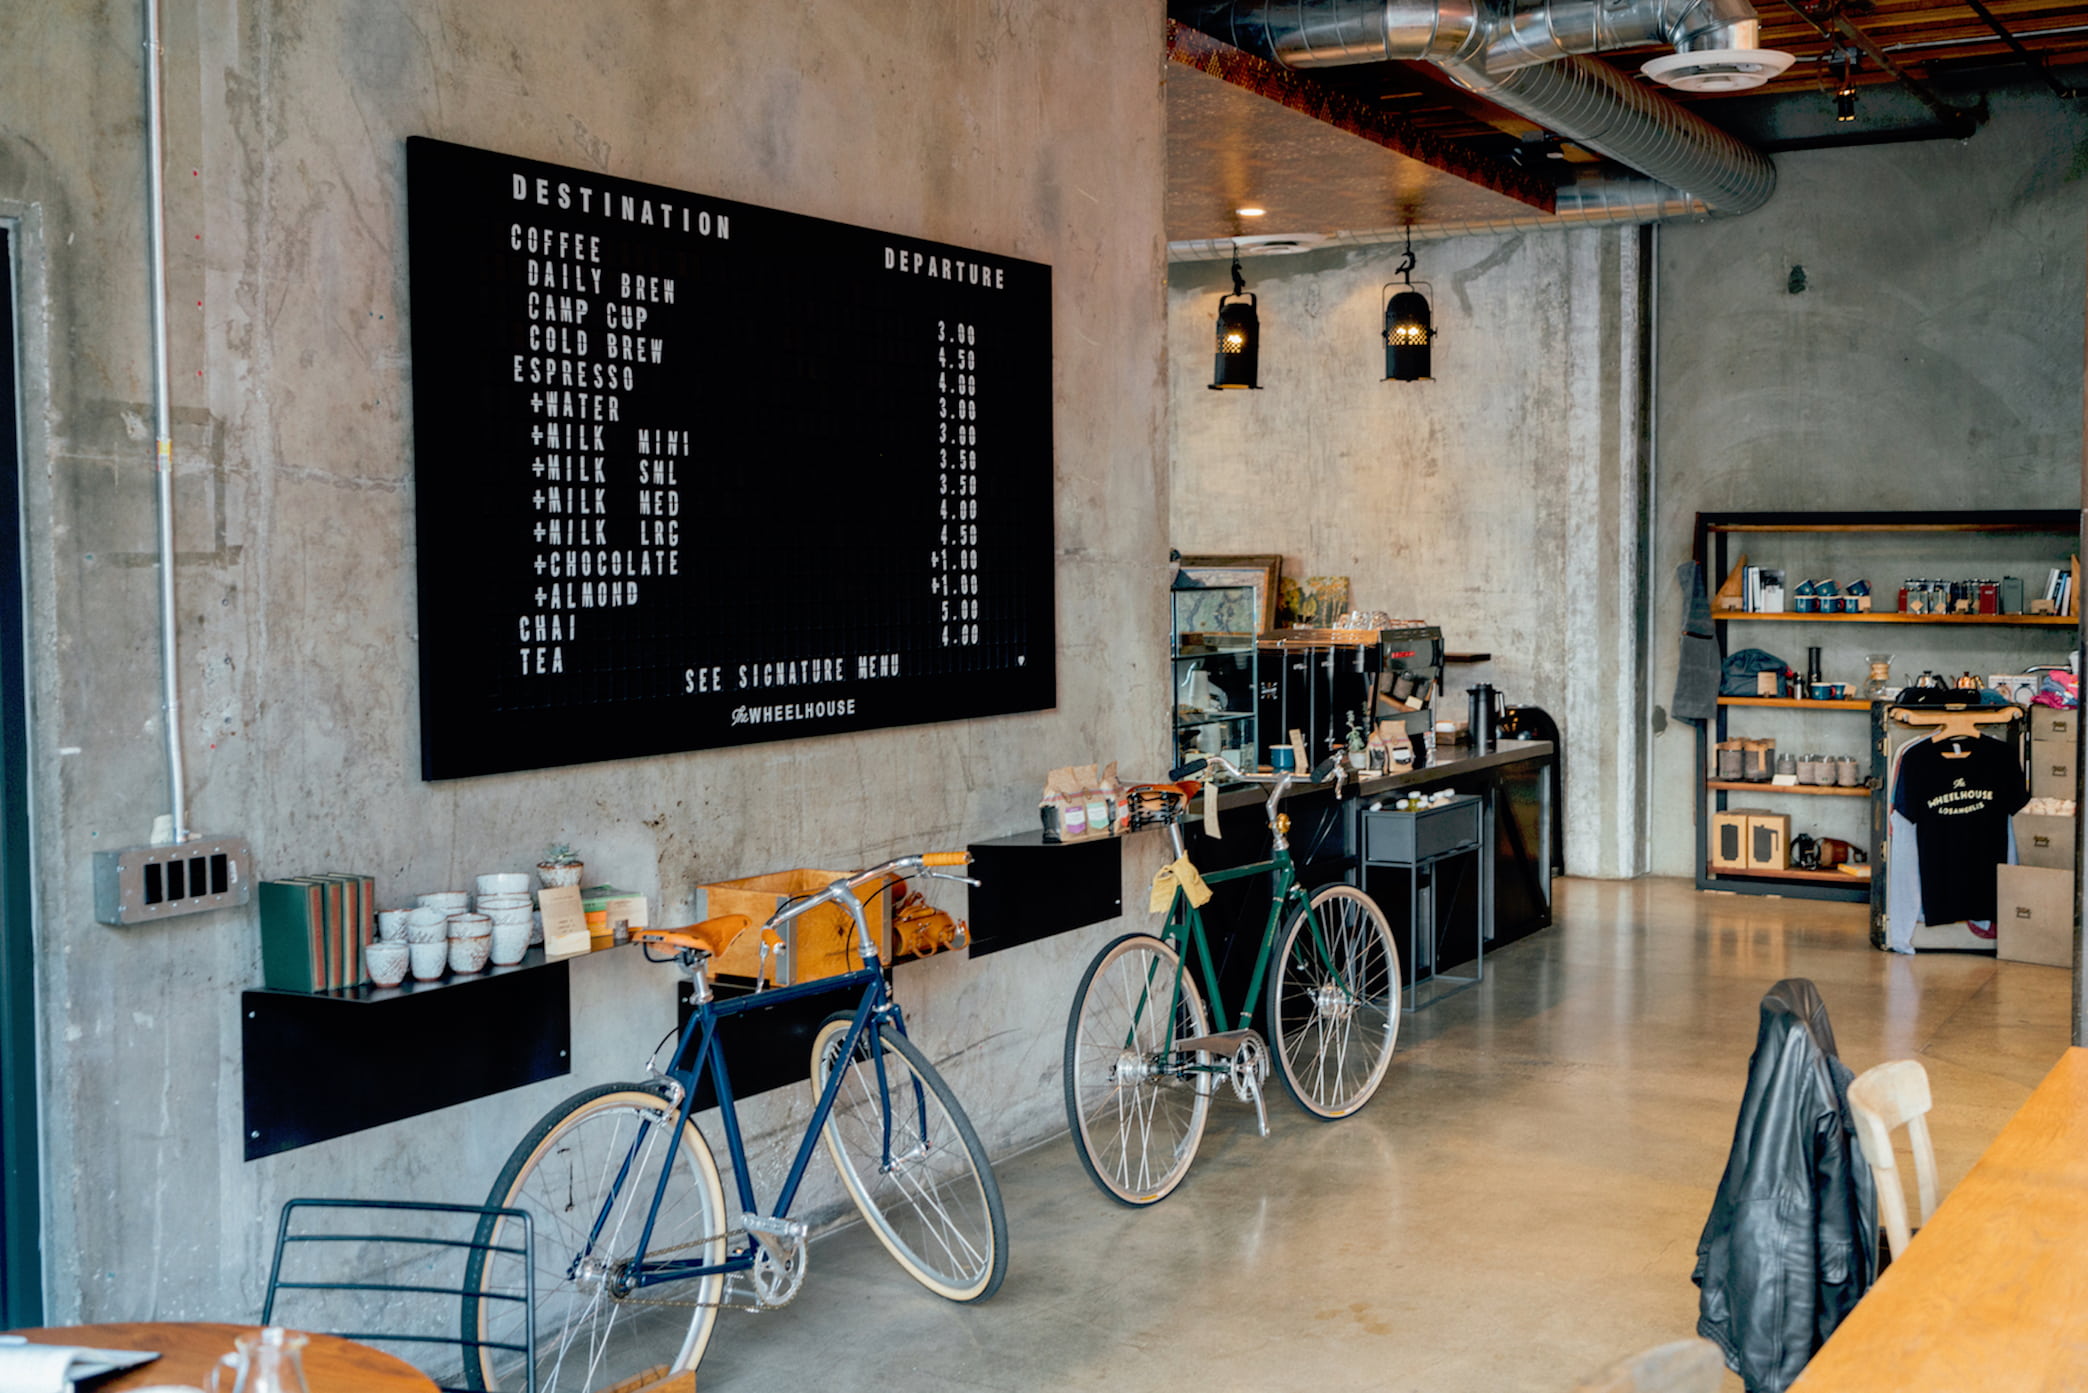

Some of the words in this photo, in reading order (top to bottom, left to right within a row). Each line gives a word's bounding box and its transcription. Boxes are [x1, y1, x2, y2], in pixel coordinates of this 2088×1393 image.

[512, 173, 730, 240] DESTINATION
[510, 223, 600, 263] COFFEE
[528, 259, 602, 295] DAILY
[621, 272, 675, 305] BREW
[884, 246, 1004, 290] DEPARTURE
[528, 291, 589, 325] CAMP
[606, 302, 648, 331] CUP
[529, 324, 588, 356] COLD
[606, 332, 663, 364] BREW
[937, 320, 975, 346] 3.00
[513, 354, 634, 392] ESPRESSO
[938, 346, 975, 371] 4.50
[938, 371, 976, 397] 4.00
[530, 390, 620, 422] +WATER
[939, 396, 977, 421] 3.00
[531, 422, 605, 452] +MILK
[638, 428, 689, 457] MINI
[939, 422, 976, 446] 3.00
[531, 453, 606, 484] +MILK
[639, 458, 677, 486] SML
[939, 447, 977, 471] 3.50
[939, 473, 977, 496] 3.50
[532, 486, 606, 515] +MILK
[639, 489, 679, 517] MED
[939, 498, 977, 521] 4.00
[533, 518, 607, 546] +MILK
[640, 519, 679, 547] LRG
[940, 524, 978, 546] 4.50
[533, 549, 679, 578] +CHOCOLATE
[930, 548, 978, 571] +1.00
[534, 581, 638, 610] +ALMOND
[931, 574, 978, 597] +1.00
[941, 599, 978, 622] 5.00
[519, 614, 575, 642] CHAI
[941, 623, 979, 647] 4.00
[519, 646, 563, 676] TEA
[685, 666, 722, 694] SEE
[738, 657, 844, 689] SIGNATURE
[858, 653, 899, 680] MENU
[731, 704, 751, 727] The
[748, 698, 856, 724] WHEELHOUSE
[1953, 777, 1966, 790] The
[1927, 789, 1993, 809] WHEELHOUSE
